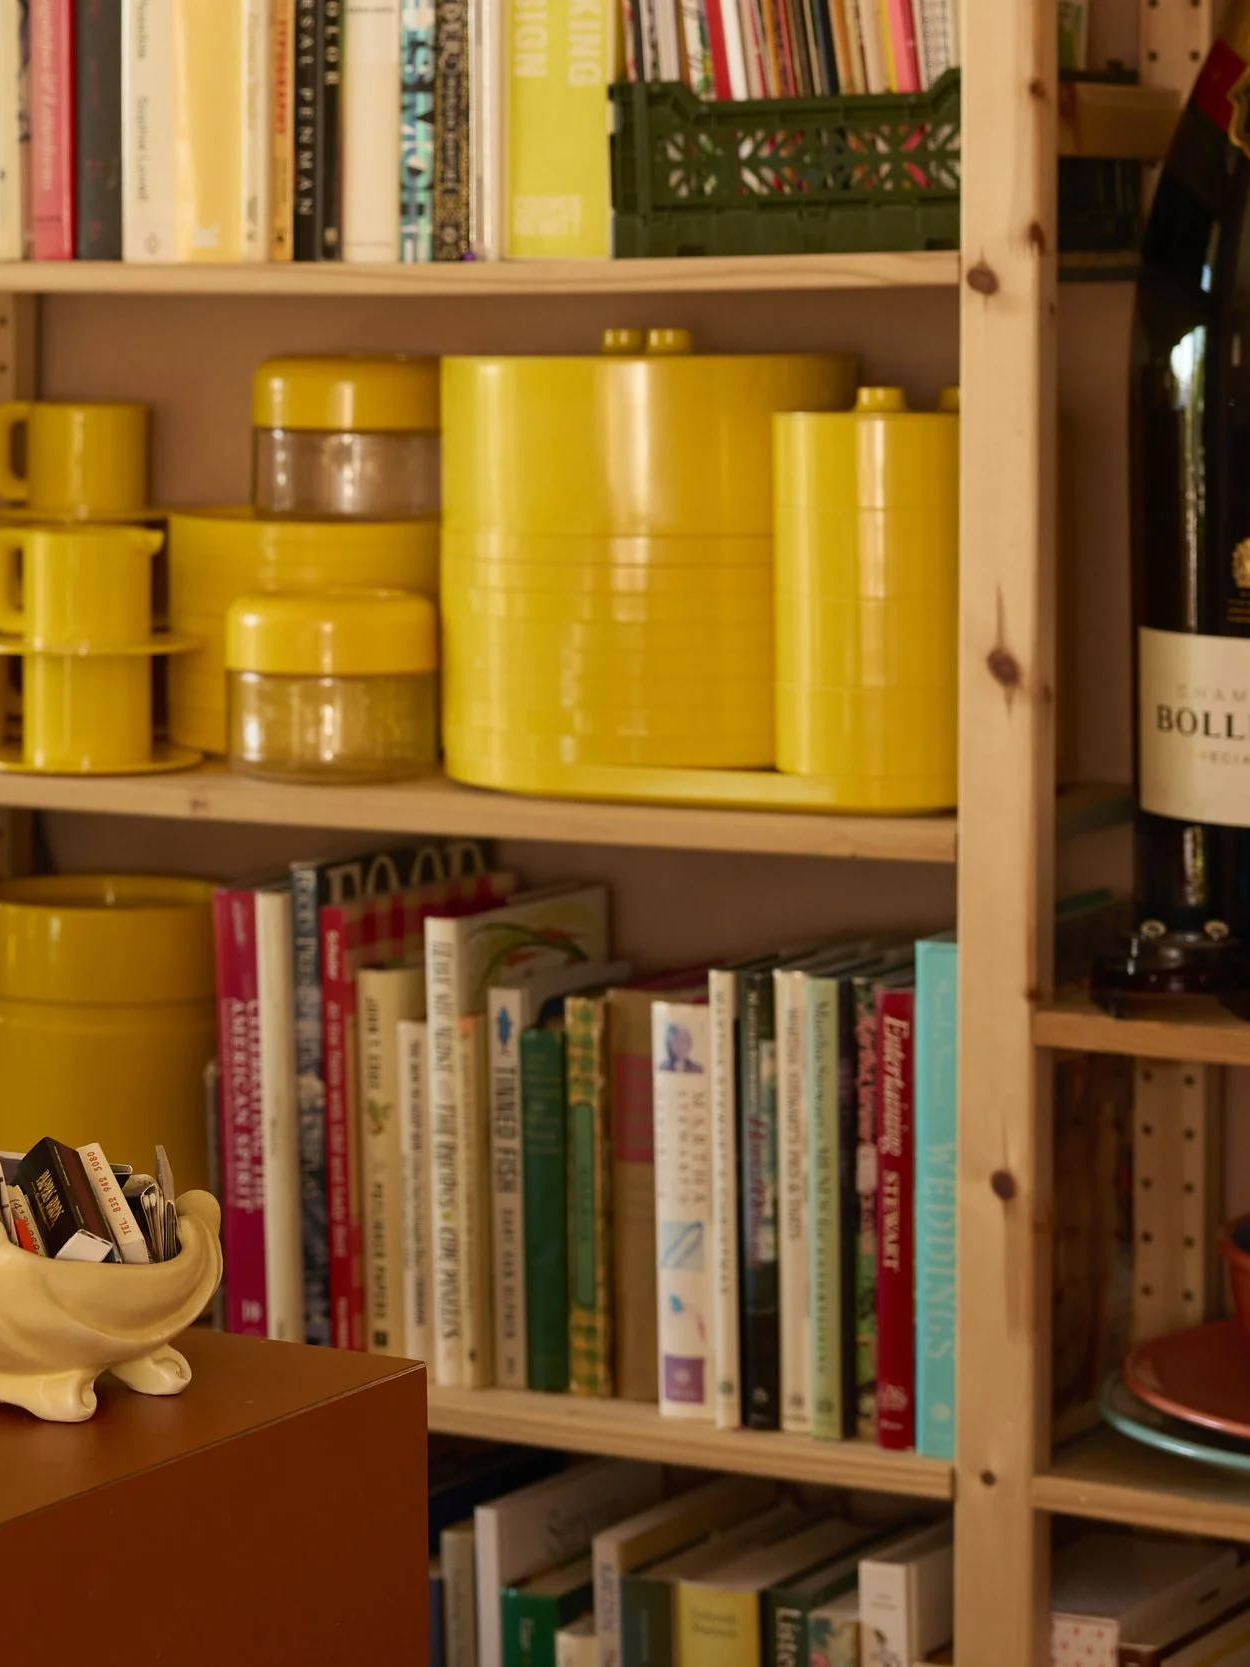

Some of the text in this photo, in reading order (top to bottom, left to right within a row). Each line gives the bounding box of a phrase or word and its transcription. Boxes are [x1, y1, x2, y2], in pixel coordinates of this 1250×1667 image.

[297, 88, 314, 216] PENMAN
[1155, 704, 1250, 743] BOLL
[231, 998, 252, 1213] AMERICAN SPIRIT
[880, 1014, 909, 1273] Entertaining STEWART
[87, 1151, 132, 1236] TEL. 832 942 5080
[495, 1146, 520, 1194] FISH
[923, 1139, 957, 1360] WEDDINGS
